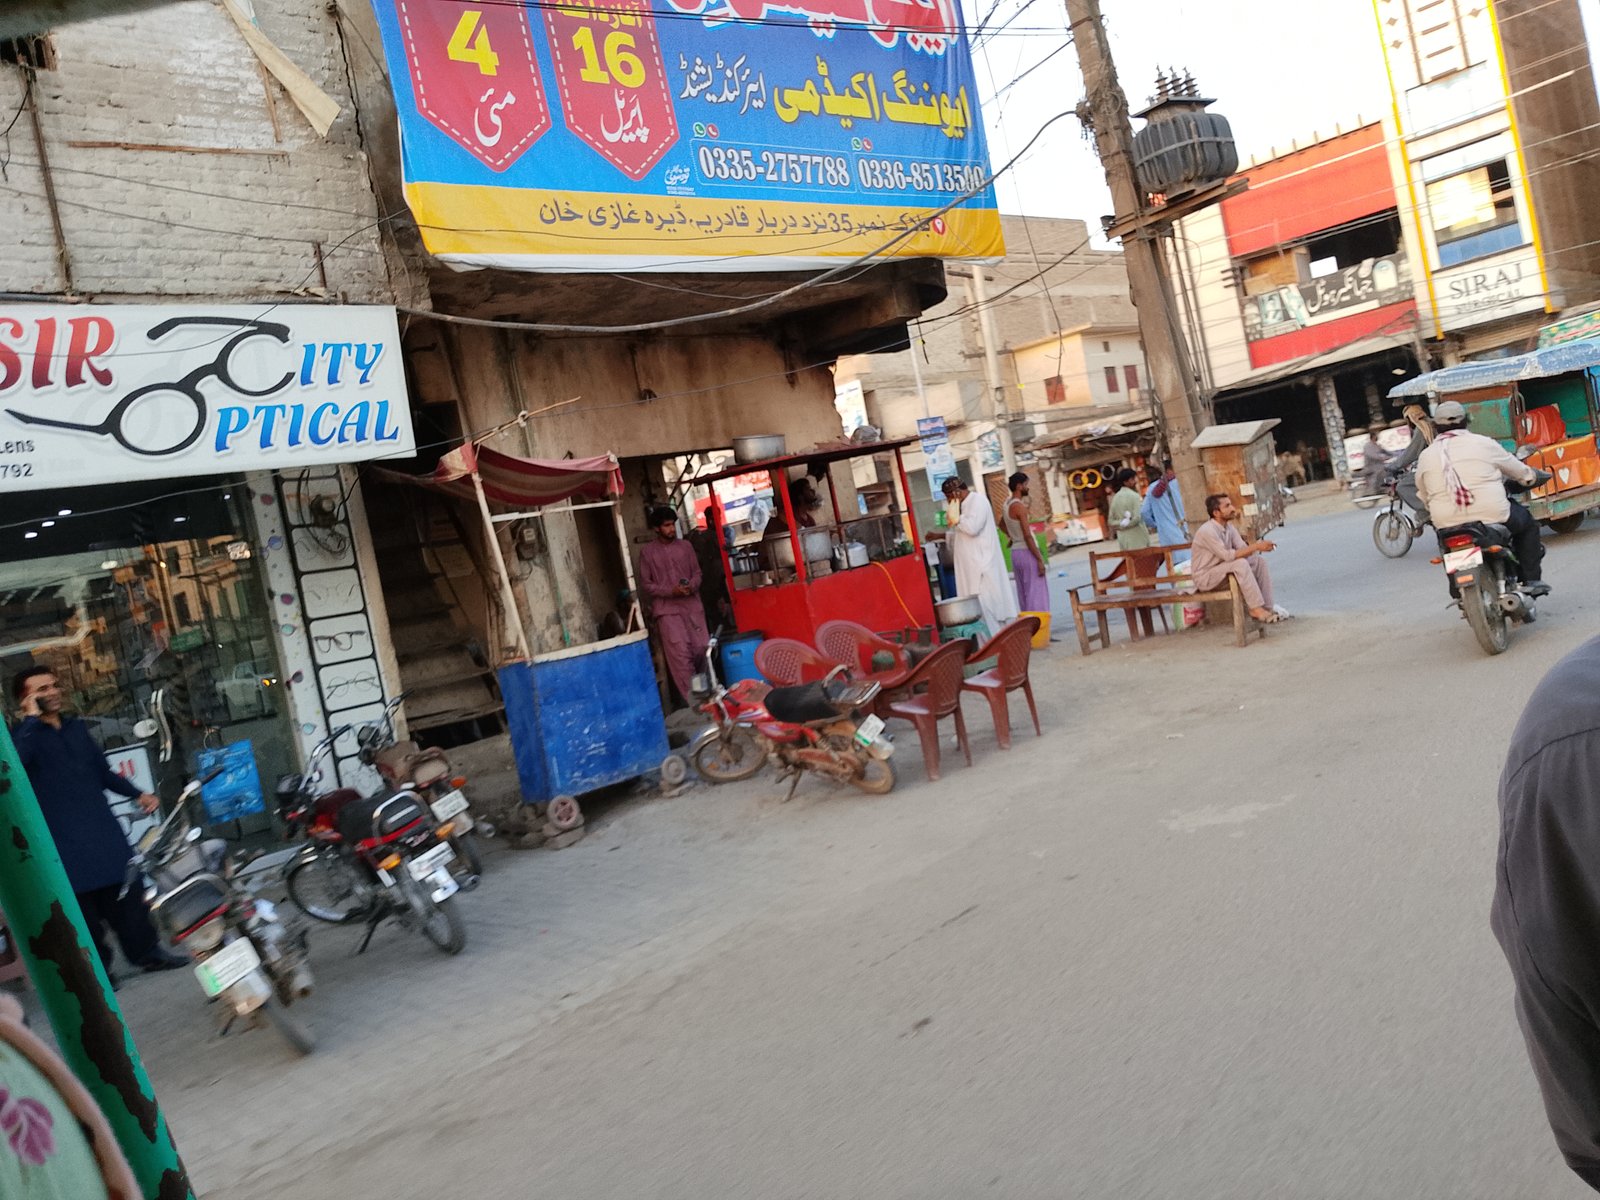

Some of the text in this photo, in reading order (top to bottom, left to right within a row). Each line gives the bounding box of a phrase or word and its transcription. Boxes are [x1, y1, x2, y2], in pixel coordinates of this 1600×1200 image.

[447, 10, 500, 77] 4
[572, 26, 646, 89] 16
[474, 87, 517, 147] مئی
[773, 55, 972, 138] ایوننگ اکیڈمی
[698, 145, 851, 187] 0335-2757788
[539, 199, 583, 225] خان
[587, 201, 641, 230] غازی
[645, 200, 687, 233] ڈیرہ
[755, 207, 797, 235] دربار
